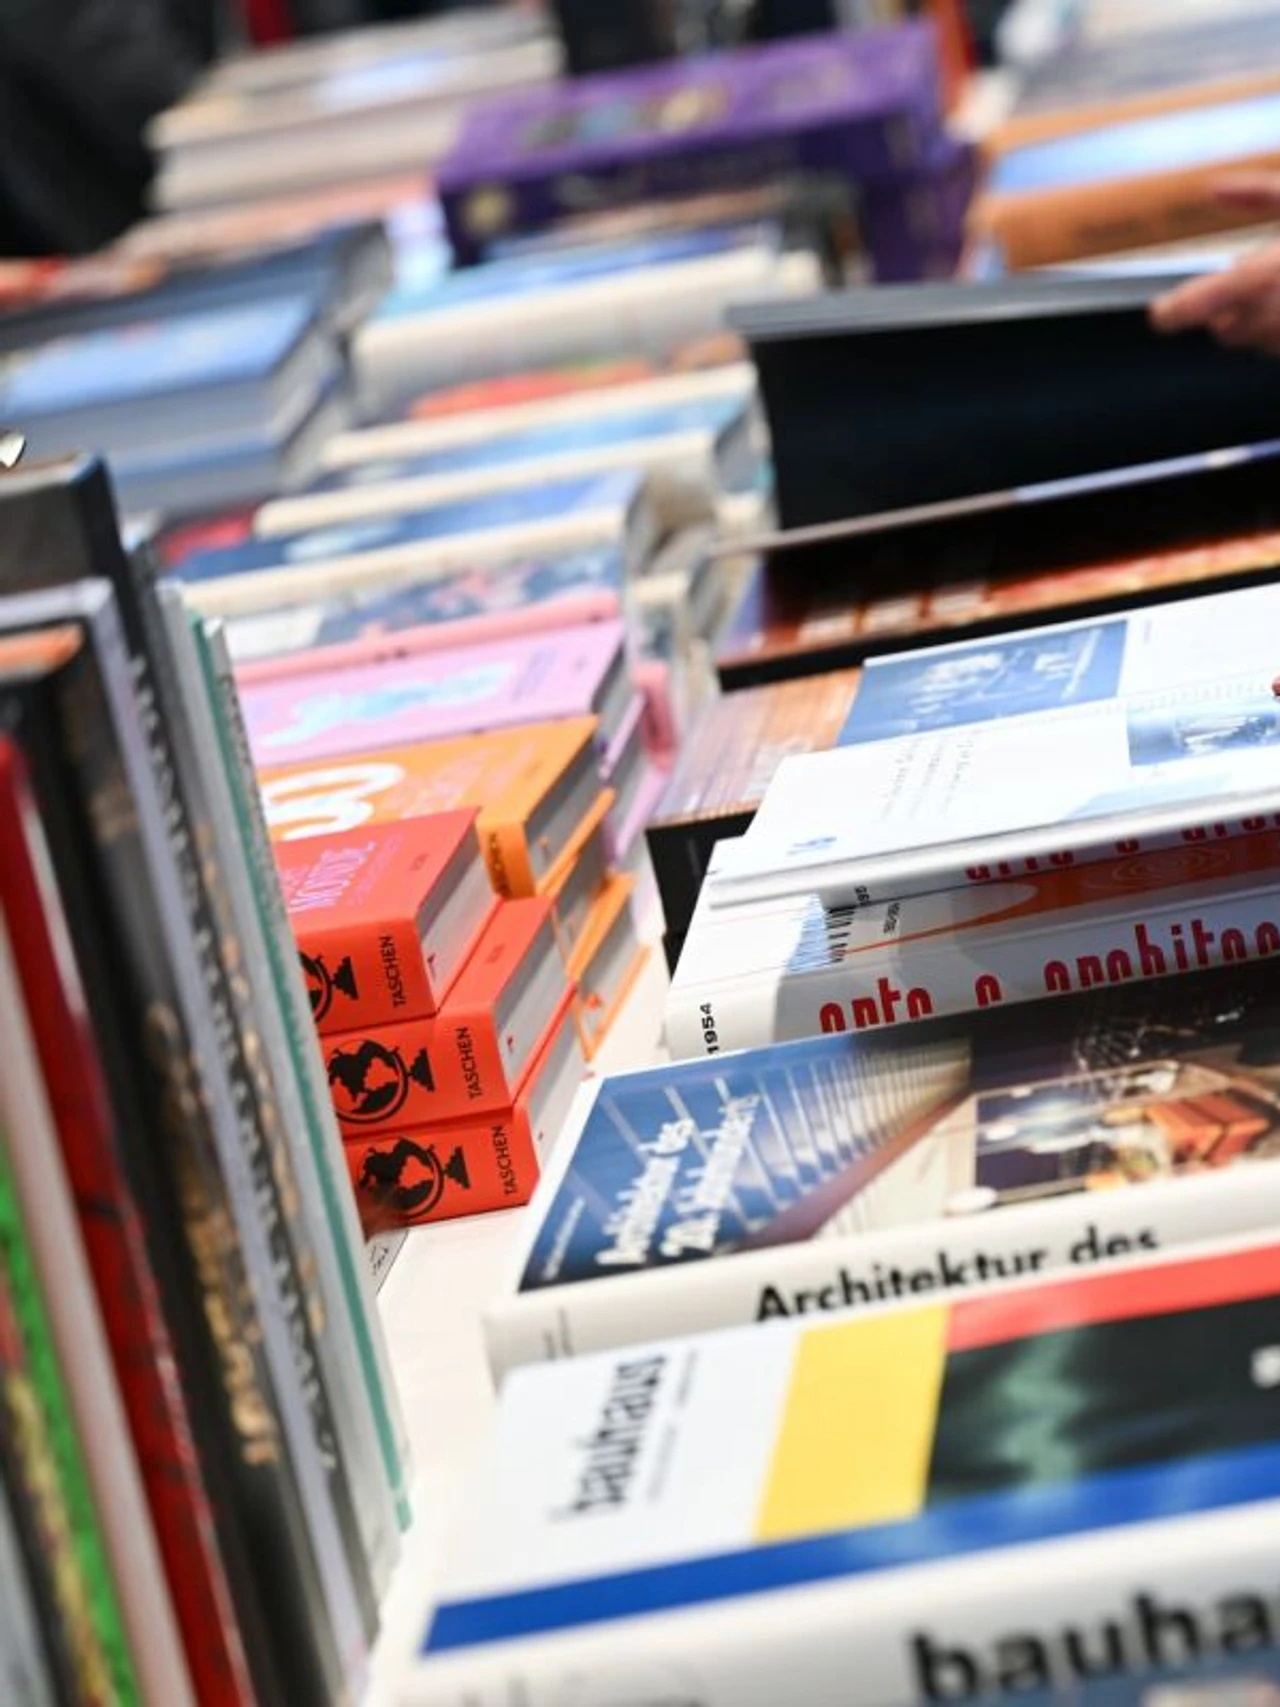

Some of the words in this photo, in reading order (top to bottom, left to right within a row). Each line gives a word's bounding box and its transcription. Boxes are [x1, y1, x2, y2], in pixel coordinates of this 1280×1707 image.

[379, 935, 406, 1008] TASCHEN
[455, 1026, 483, 1100] TASCHEN
[700, 1002, 719, 1054] 1954
[491, 1125, 517, 1196] TASCHEN
[754, 1249, 1048, 1322] Architektur
[1068, 1225, 1161, 1265] des
